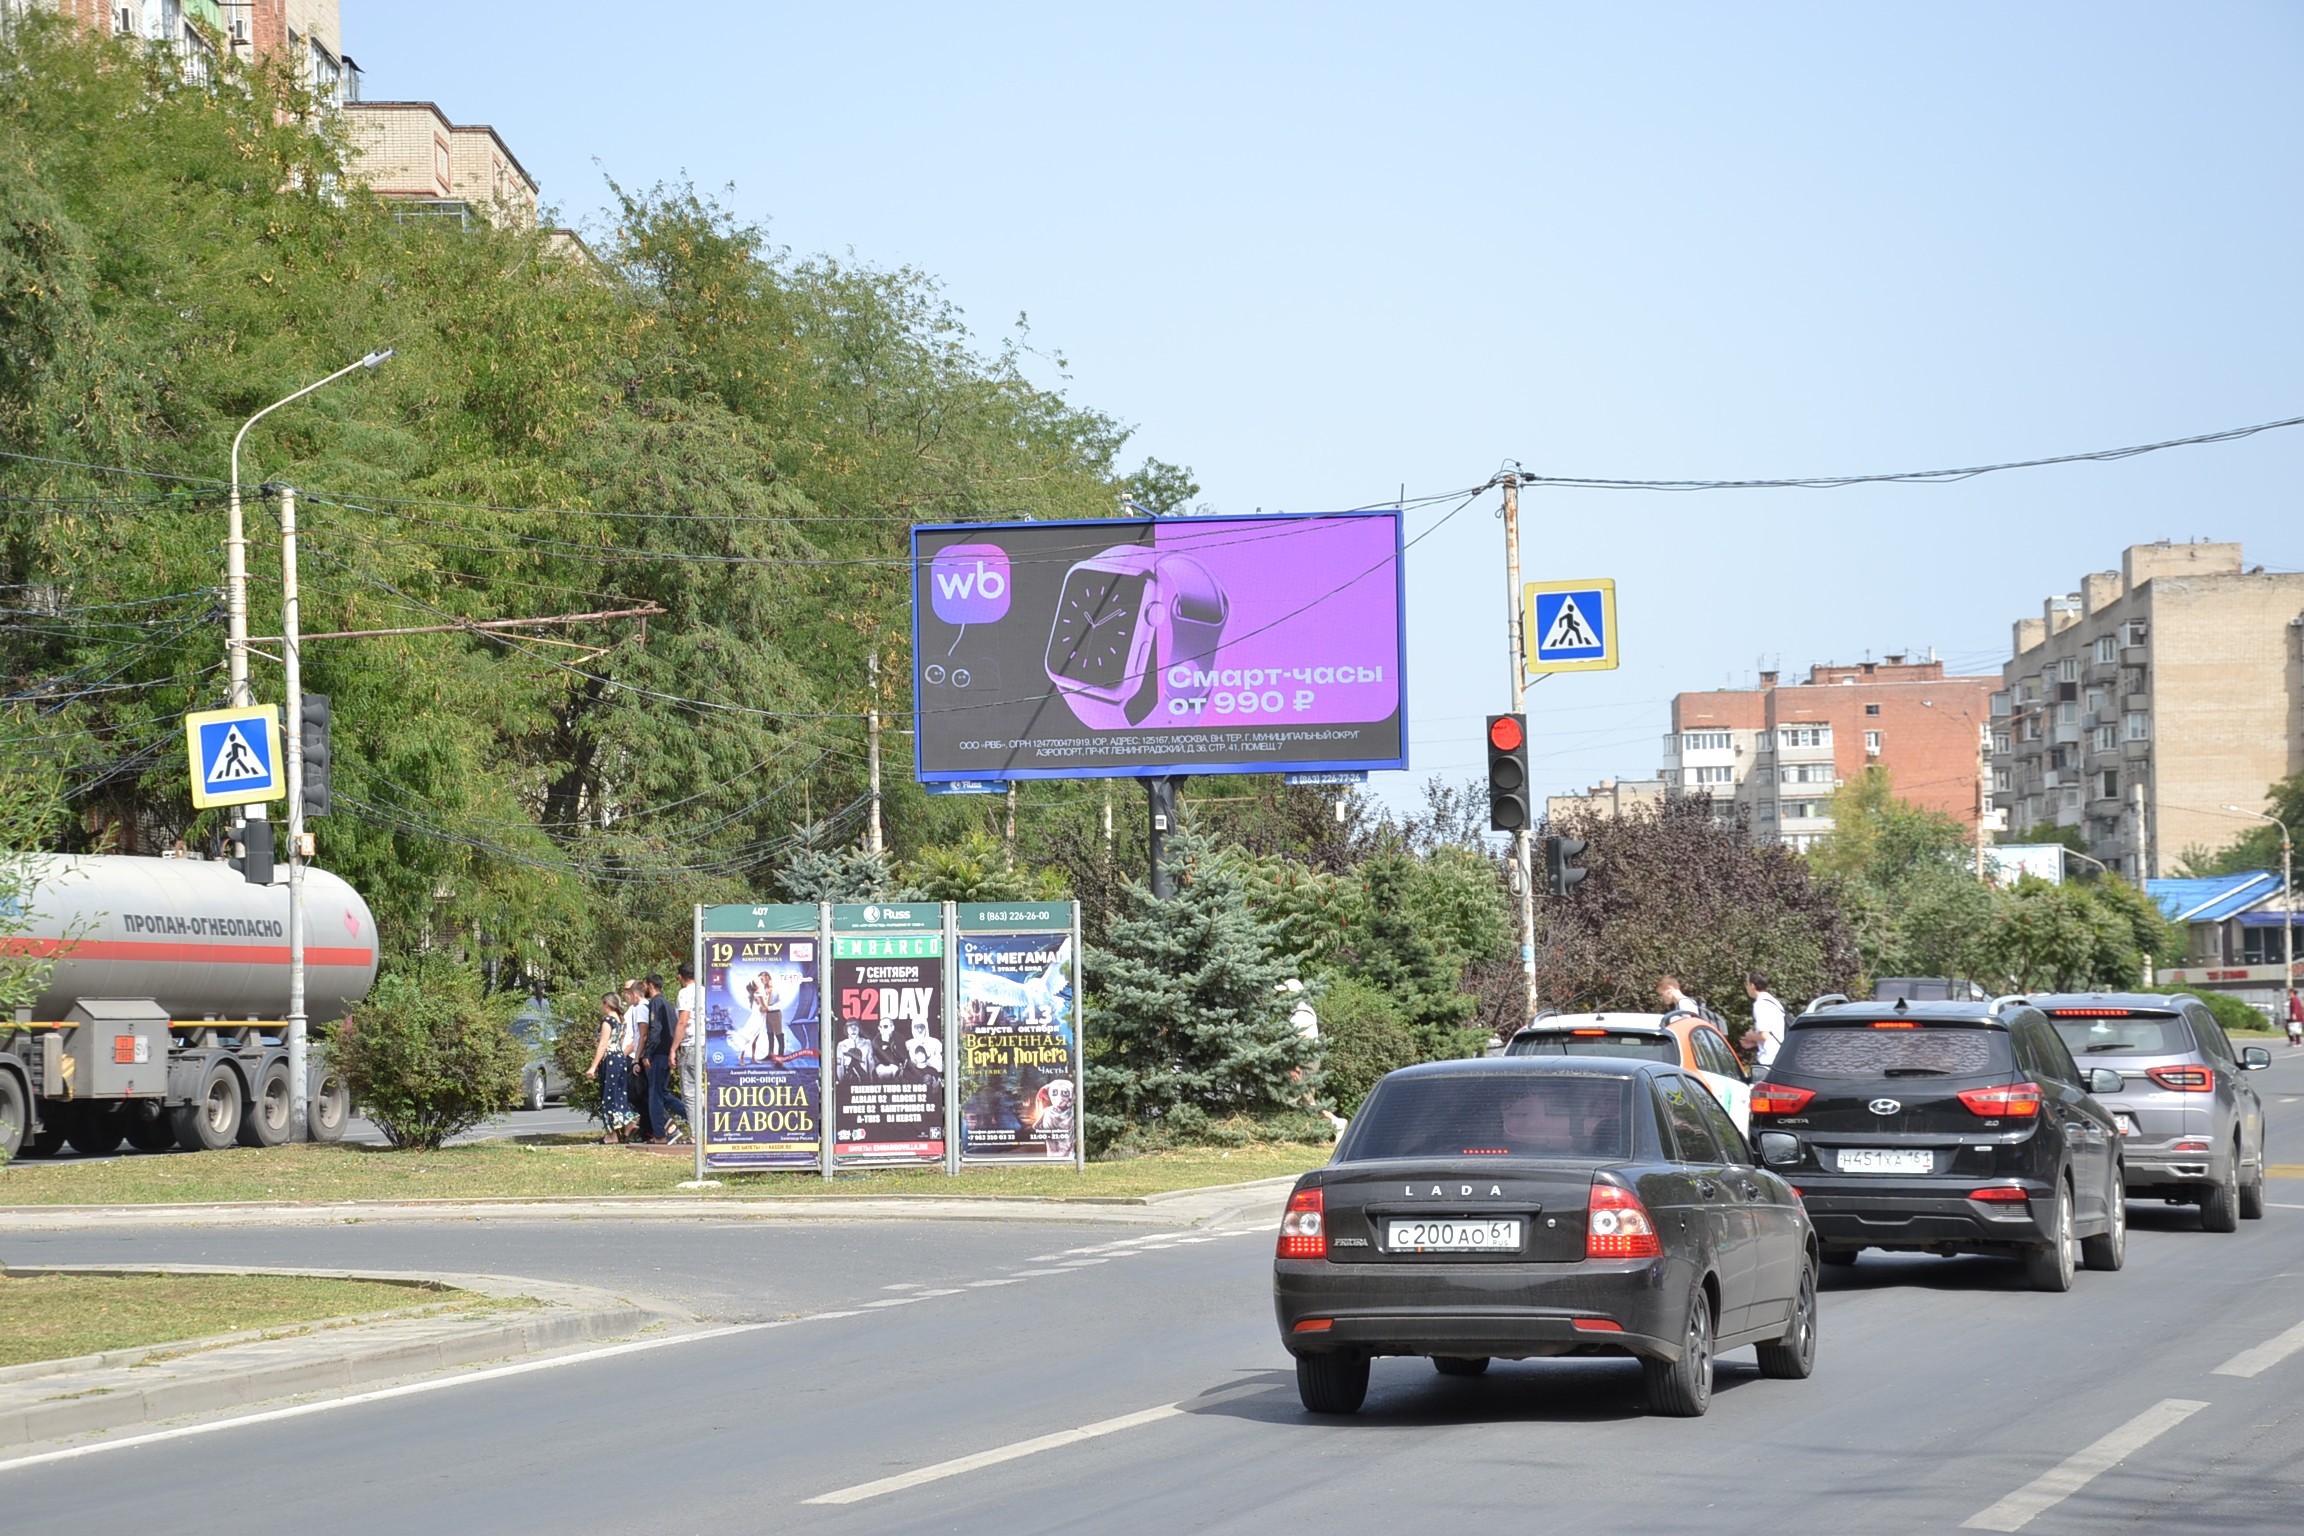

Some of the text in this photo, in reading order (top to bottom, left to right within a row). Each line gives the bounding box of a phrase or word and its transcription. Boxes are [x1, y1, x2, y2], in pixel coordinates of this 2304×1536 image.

[936, 561, 1005, 600] wb
[1167, 665, 1383, 690] Смарт-часы
[1168, 697, 1207, 715] от
[1213, 690, 1285, 714] 990
[959, 741, 980, 750] ООО
[1009, 739, 1032, 749] ОГРН
[1110, 736, 1141, 746] АДРЕС:
[1252, 730, 1332, 742] МУНИЦИПАЛЬНЫЙ
[1332, 730, 1360, 740] ОКРУГ
[1036, 748, 1084, 757] АЭРОПОРТ,
[1085, 747, 1110, 756] ПР-КТ
[1277, 742, 1283, 750] 7
[1291, 774, 1360, 784] 8 (863) 226-77-26
[752, 907, 769, 916] 407
[883, 908, 911, 919] Russ
[979, 911, 1050, 922] 8 (863) 226-26-00
[123, 914, 284, 938] ПРОПАН-ОГНЕОПАСНО
[711, 943, 733, 962] 19
[742, 943, 783, 957] ДГТУ
[836, 939, 939, 956] EMBARGO
[964, 943, 978, 953] 0+
[964, 952, 995, 965] ТРК
[855, 966, 919, 984] 7 СЕНТЯБРЯ
[985, 1004, 1053, 1026] 7 13
[974, 1023, 1060, 1035] августа октября
[739, 1075, 787, 1086] рок-опера
[717, 1085, 809, 1107] ЮНОНА
[712, 1110, 814, 1132] И АВОСЬ
[1405, 1185, 1502, 1197] LADA
